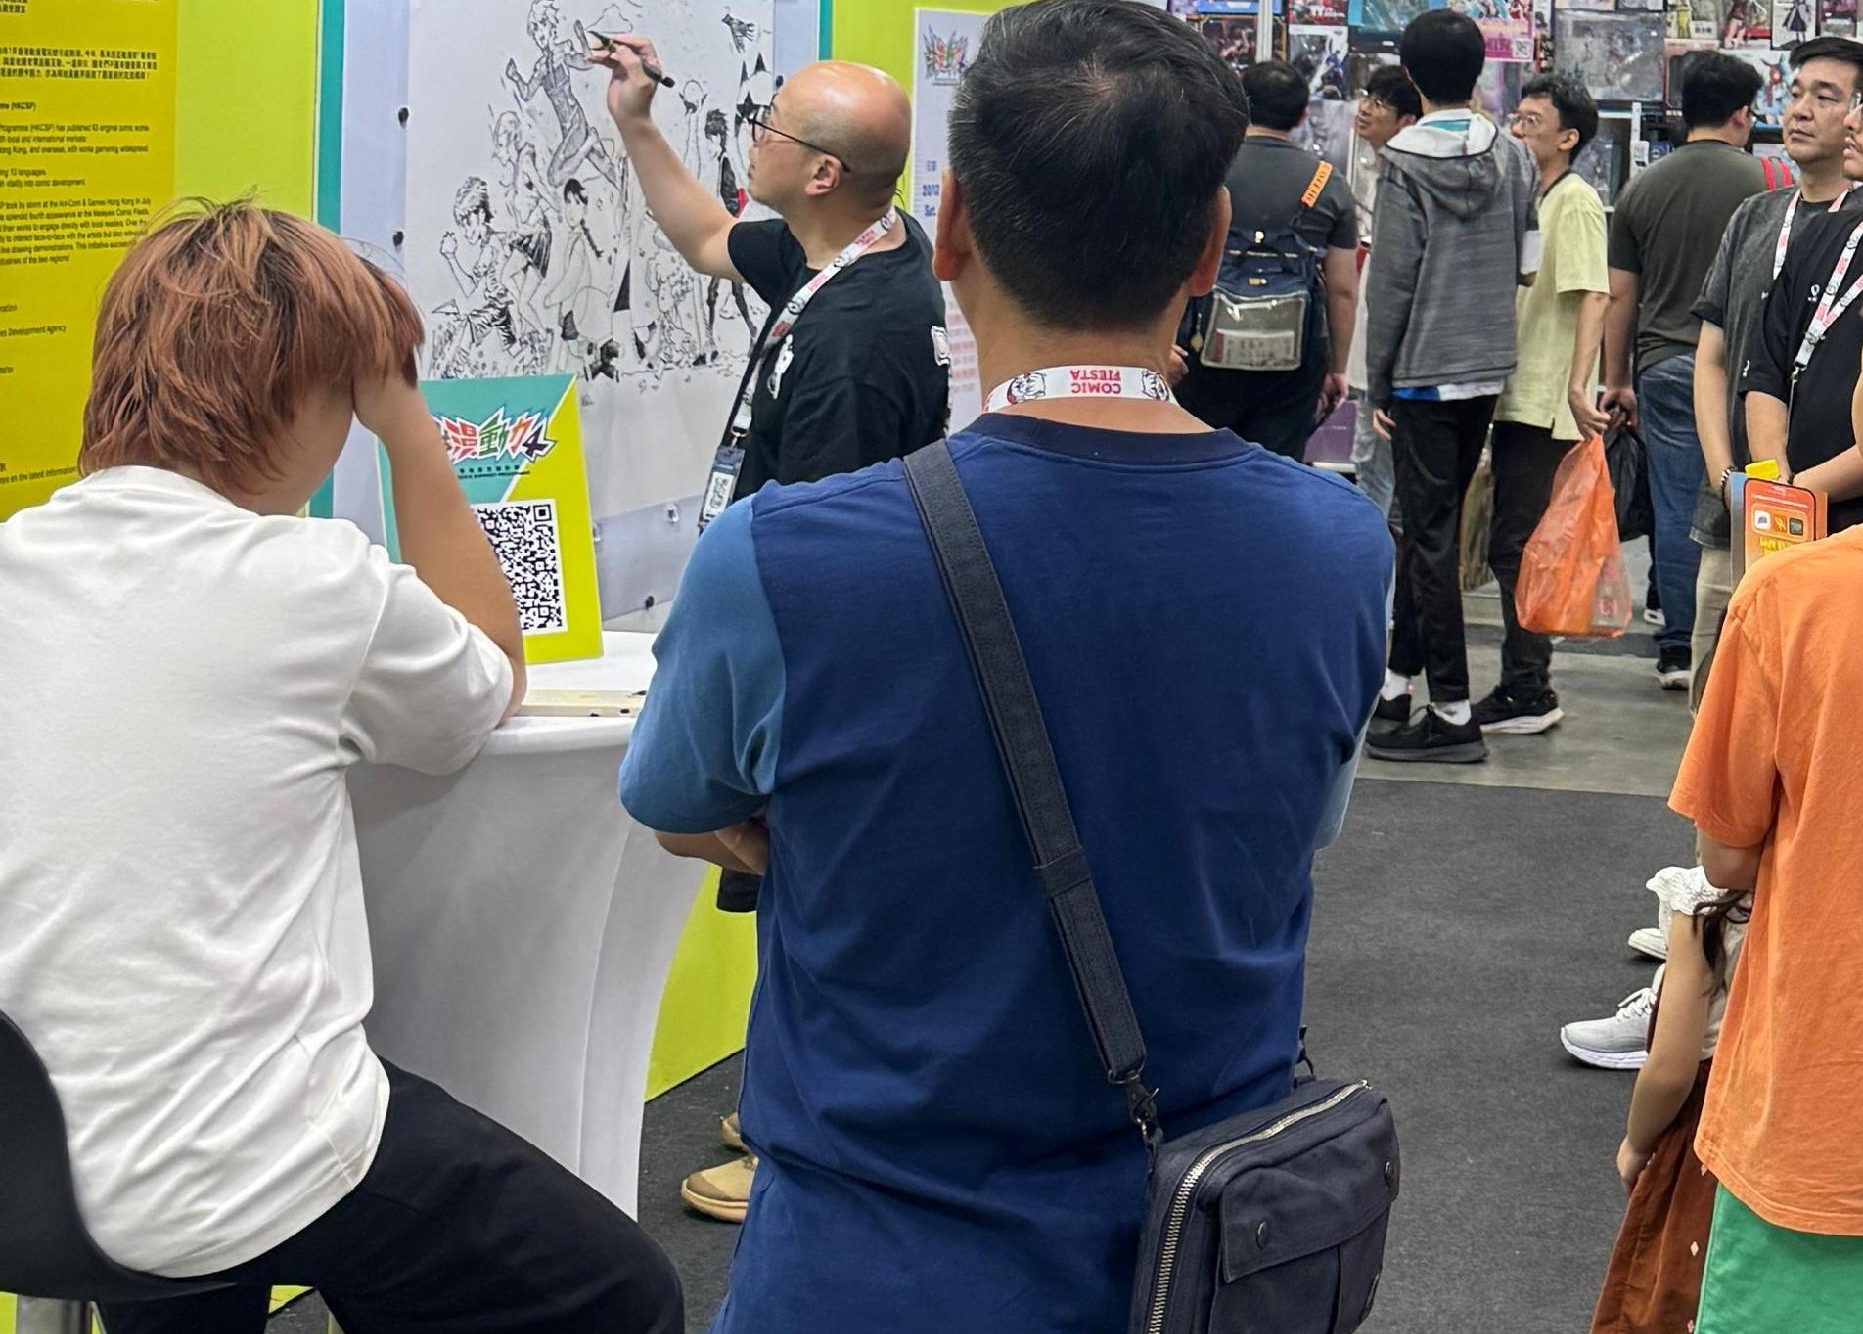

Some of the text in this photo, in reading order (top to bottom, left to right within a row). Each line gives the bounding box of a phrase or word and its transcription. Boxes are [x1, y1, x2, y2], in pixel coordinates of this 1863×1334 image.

[1070, 369, 1121, 382] FIESTA
[1070, 382, 1122, 395] COMIC
[441, 411, 548, 459] 漫動力4
